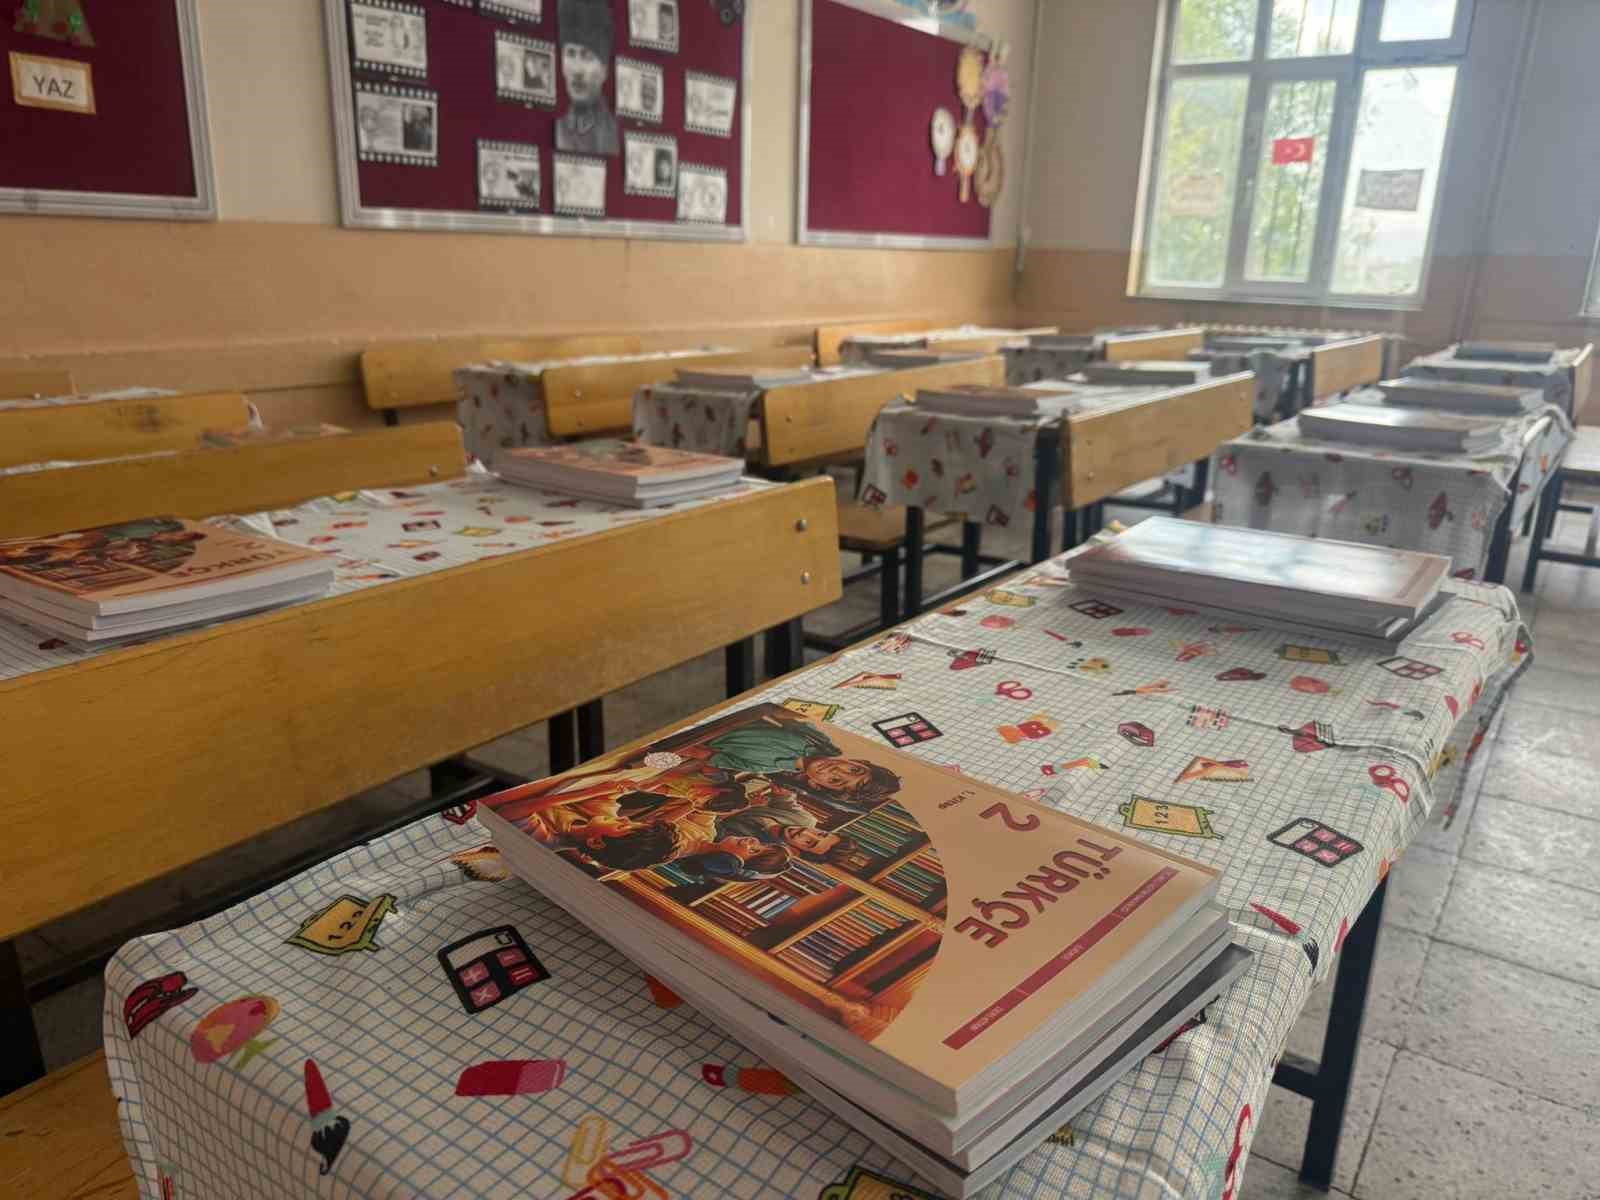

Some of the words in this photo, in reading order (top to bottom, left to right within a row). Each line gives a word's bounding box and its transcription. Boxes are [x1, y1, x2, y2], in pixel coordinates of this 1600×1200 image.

[32, 75, 75, 99] YAZ
[979, 802, 1041, 832] 2
[953, 838, 1123, 949] TÜRKÇE
